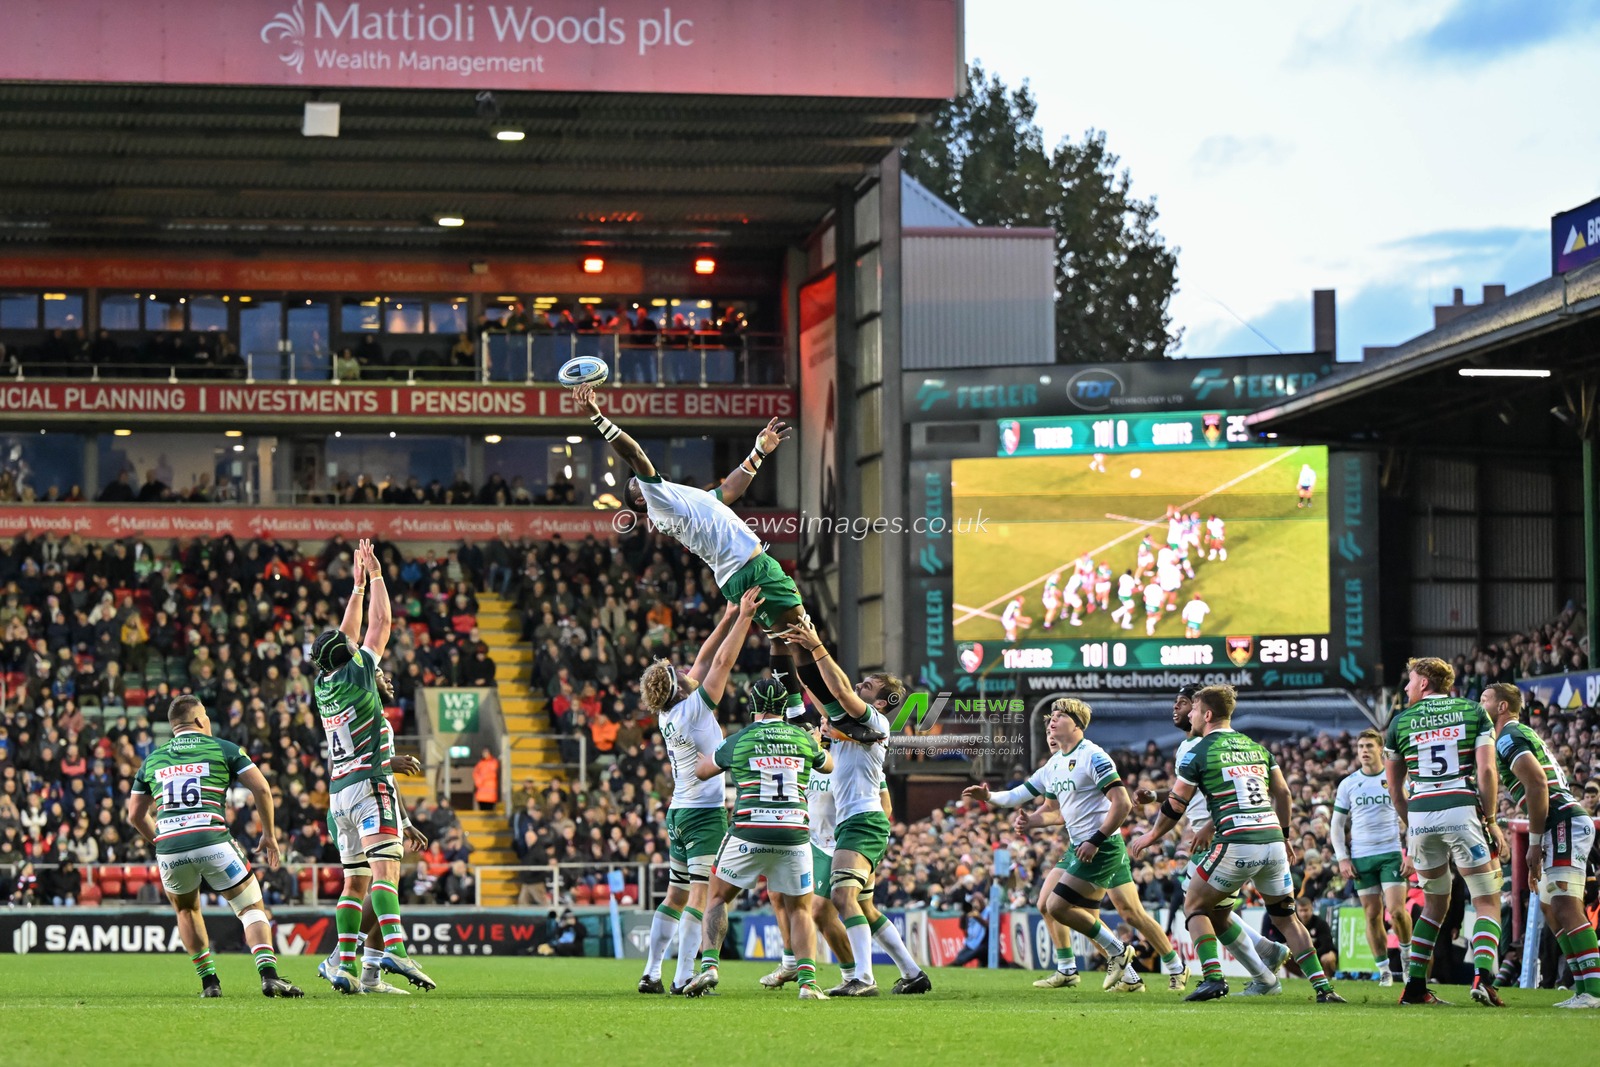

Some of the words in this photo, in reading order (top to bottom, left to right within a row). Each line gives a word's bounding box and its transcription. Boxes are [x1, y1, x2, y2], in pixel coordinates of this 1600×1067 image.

[314, 2, 475, 42] Mattioli
[487, 6, 626, 45] Woods
[638, 7, 695, 56] plc
[314, 48, 391, 69] Wealth
[398, 50, 545, 76] Management
[65, 388, 186, 410] PLANNING
[1075, 381, 1116, 398] TDT
[1110, 394, 1164, 405] TECHNOLOGY
[220, 389, 379, 412] INVESTMENTS
[411, 391, 526, 414] PENSIONS
[684, 393, 792, 415] BENEFITS
[1259, 637, 1328, 664] 29:31
[1028, 668, 1253, 692] www.tdt-technology.co.uk
[443, 693, 475, 709] W5
[1415, 727, 1460, 744] KINGS
[755, 756, 800, 769] KINGS
[1220, 750, 1265, 765] CRACKNELL
[1430, 743, 1449, 776] 5
[160, 763, 204, 779] KINGS
[1227, 764, 1265, 778] KINGS
[164, 777, 201, 808] 16
[771, 772, 790, 802] 1
[1246, 778, 1265, 807] 8
[1355, 792, 1392, 806] cinch
[160, 813, 211, 827] TRADEVIEW
[168, 851, 225, 872] globalpayments
[720, 866, 738, 879] wilo
[407, 943, 493, 956] ARKETS
